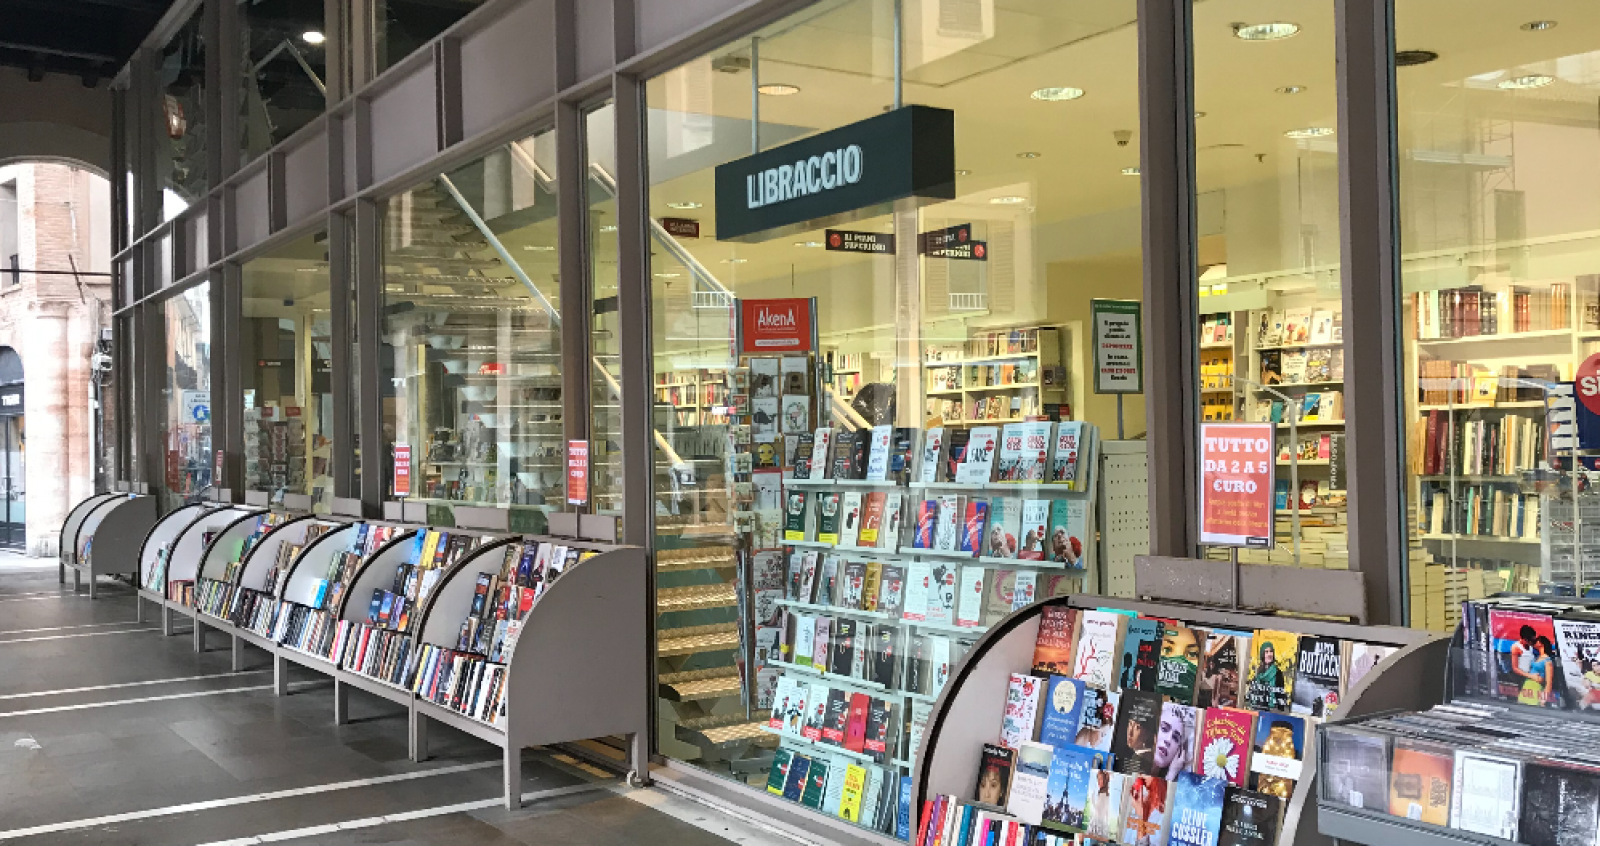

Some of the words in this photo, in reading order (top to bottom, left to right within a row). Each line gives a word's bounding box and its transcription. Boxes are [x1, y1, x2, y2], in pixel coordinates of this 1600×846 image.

[747, 144, 863, 209] LIBRACCIO
[758, 306, 796, 326] AkenA
[1205, 437, 1269, 453] TUTTO
[1205, 459, 1227, 473] DA
[1230, 460, 1240, 473] 2
[1243, 461, 1255, 474] A
[1258, 461, 1268, 474] 5
